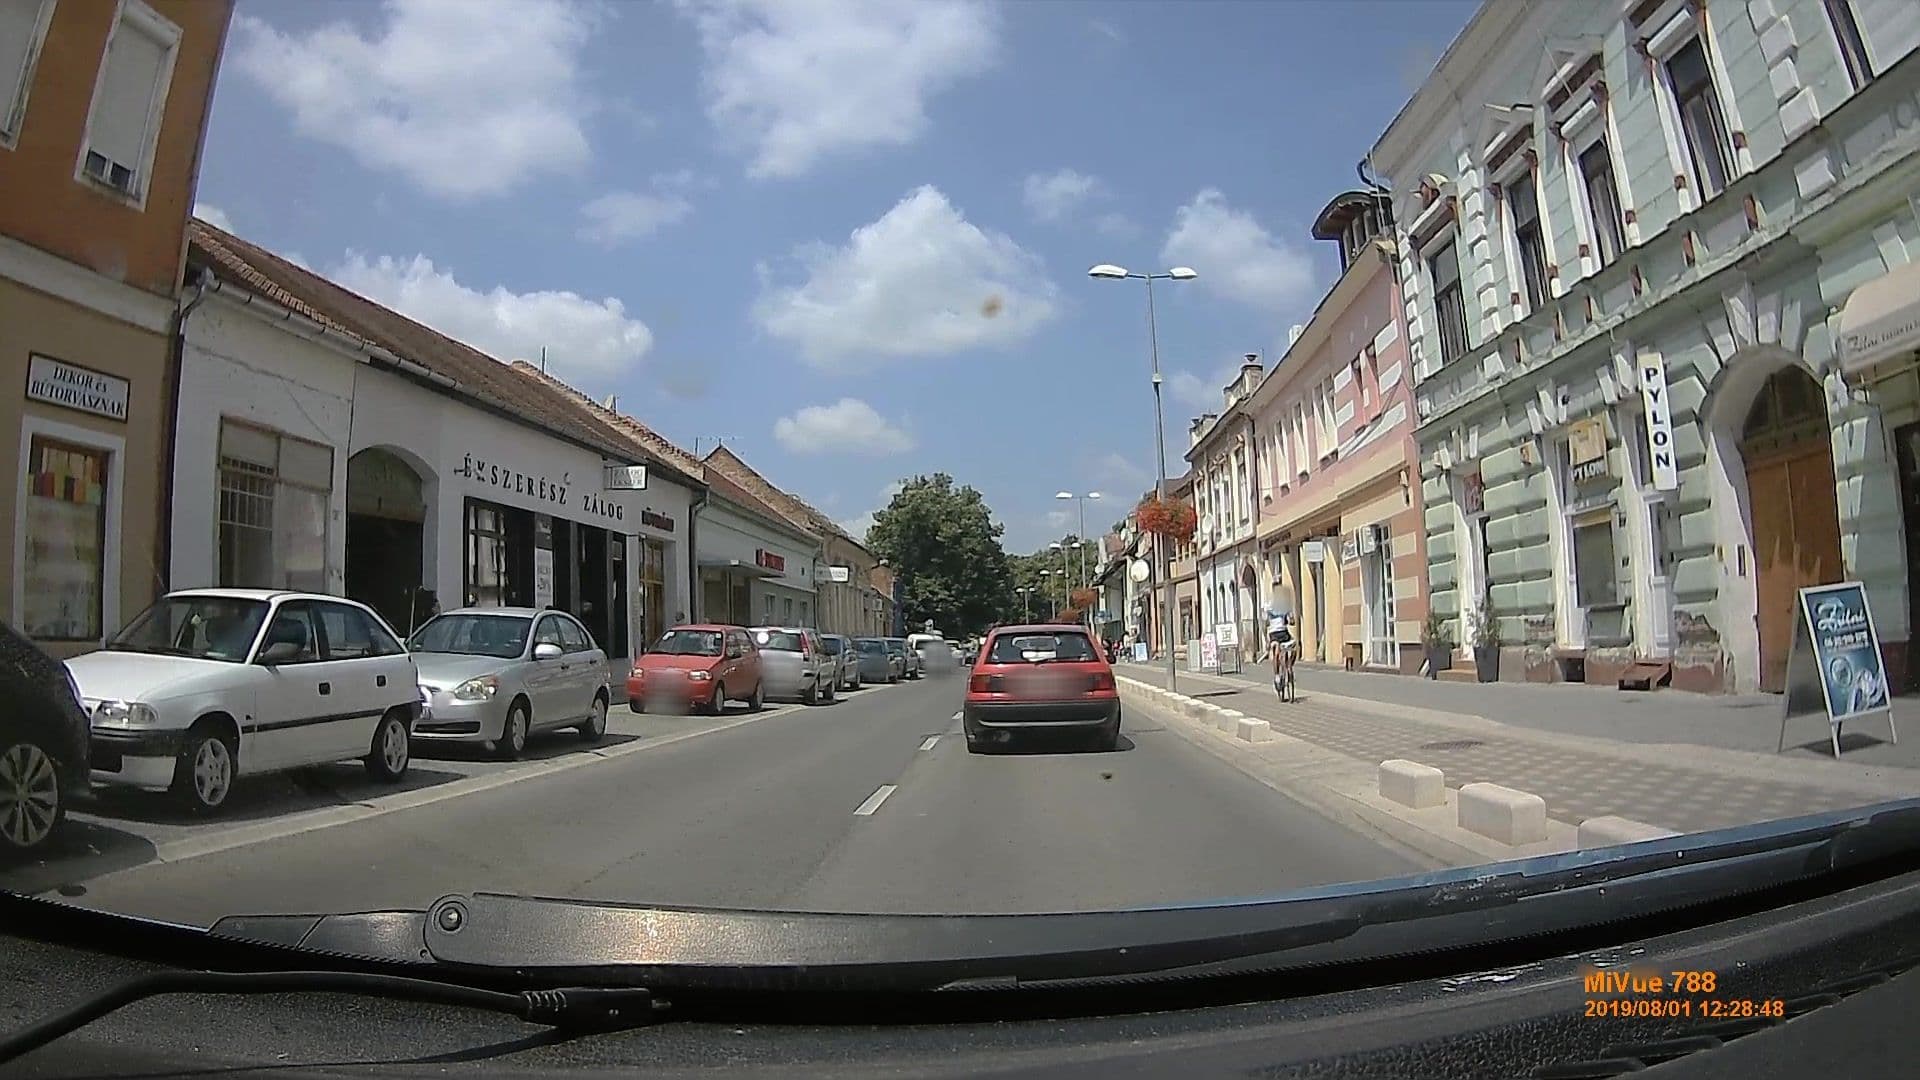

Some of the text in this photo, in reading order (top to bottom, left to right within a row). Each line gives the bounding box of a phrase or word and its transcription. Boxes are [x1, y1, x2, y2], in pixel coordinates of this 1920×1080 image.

[54, 366, 94, 389] DEKOR
[1645, 366, 1671, 469] PYLON
[583, 493, 624, 521] ZÁLOG
